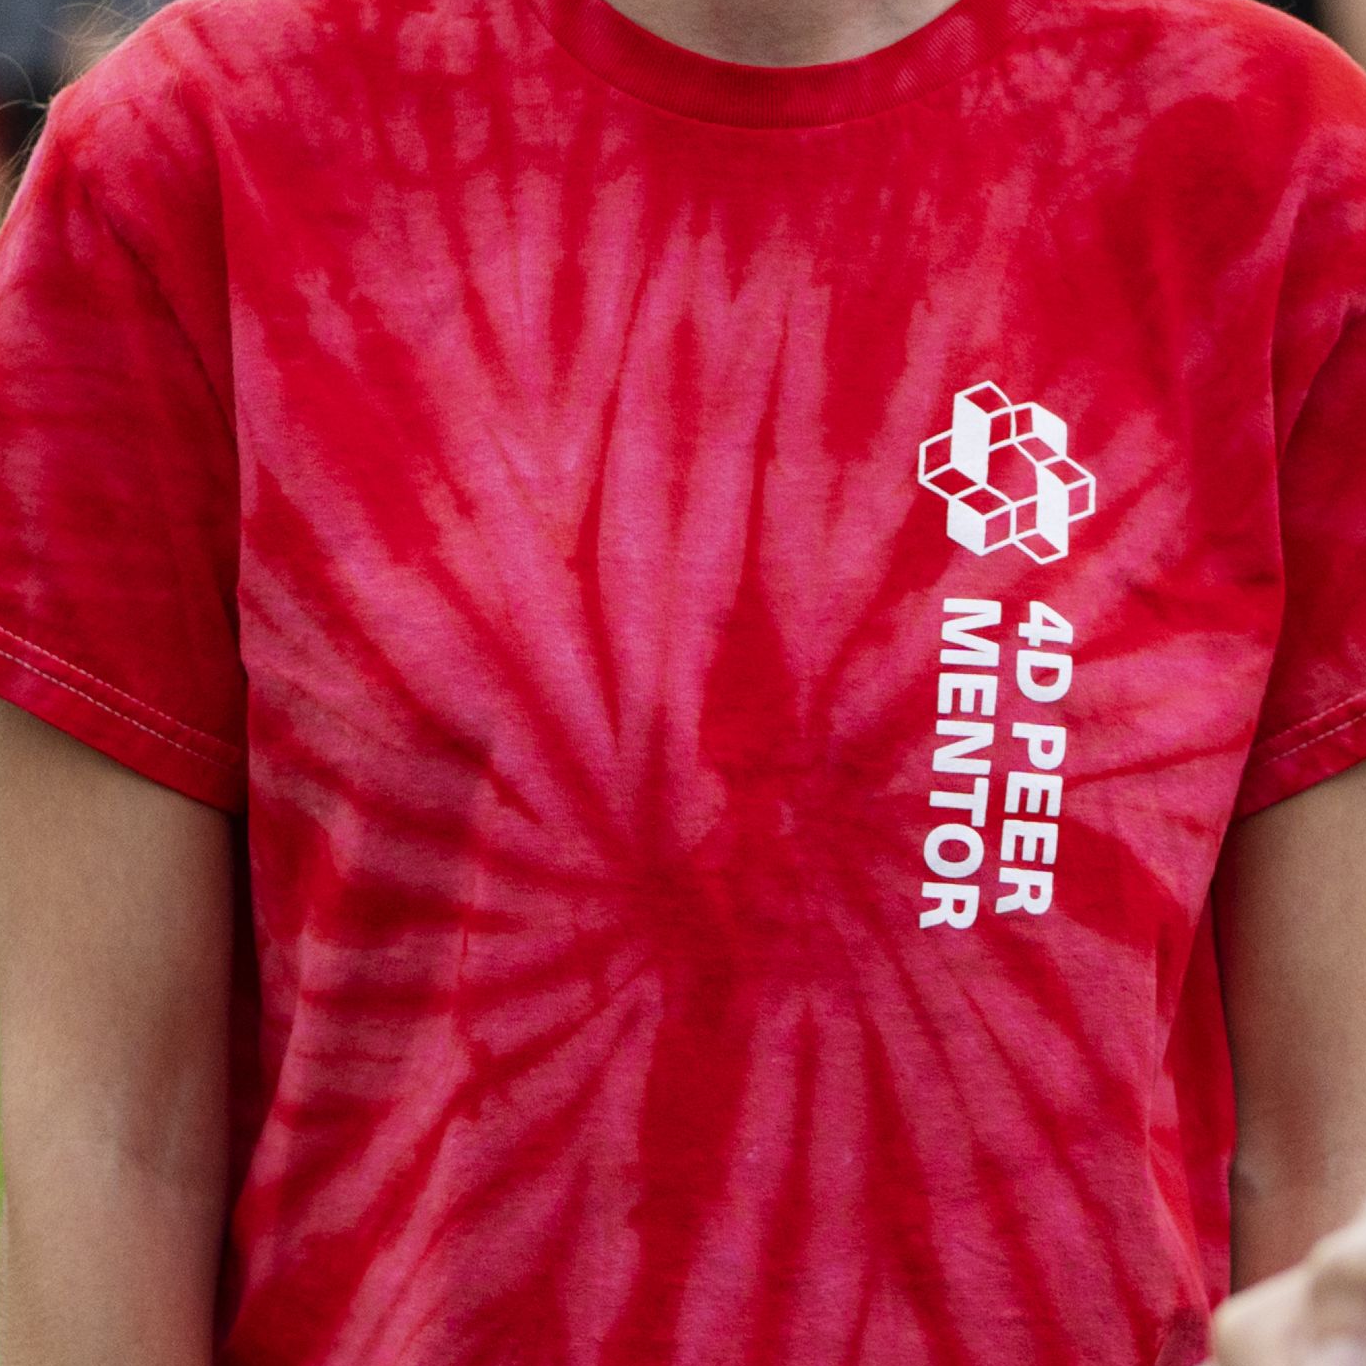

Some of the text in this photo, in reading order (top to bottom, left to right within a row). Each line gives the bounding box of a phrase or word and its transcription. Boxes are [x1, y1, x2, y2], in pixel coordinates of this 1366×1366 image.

[919, 598, 1002, 929] MENTOR
[995, 600, 1073, 915] 4D PEER
